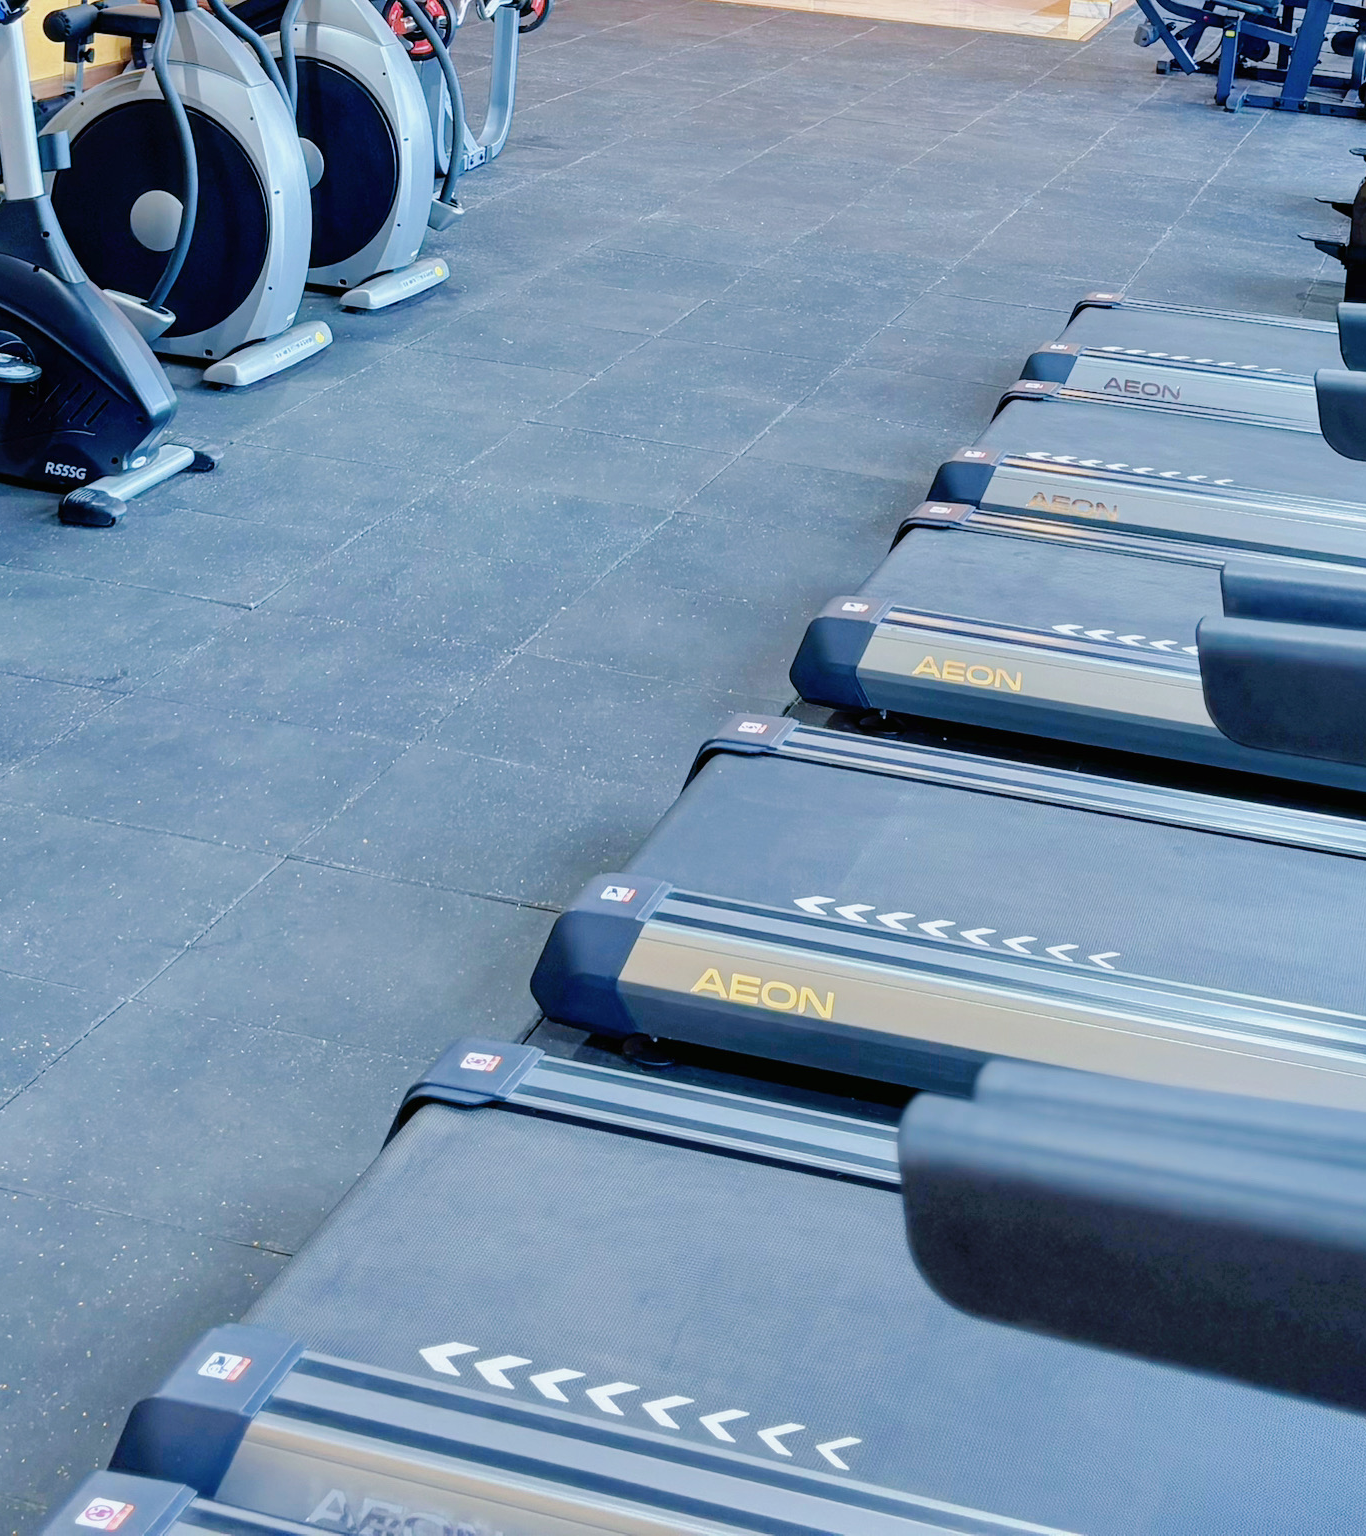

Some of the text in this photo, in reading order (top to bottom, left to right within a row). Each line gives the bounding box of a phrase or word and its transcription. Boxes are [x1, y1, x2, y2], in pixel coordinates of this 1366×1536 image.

[1102, 376, 1181, 400] AEON
[1025, 491, 1118, 523] AEON
[911, 655, 1023, 693] AEON
[690, 967, 835, 1020] AEON
